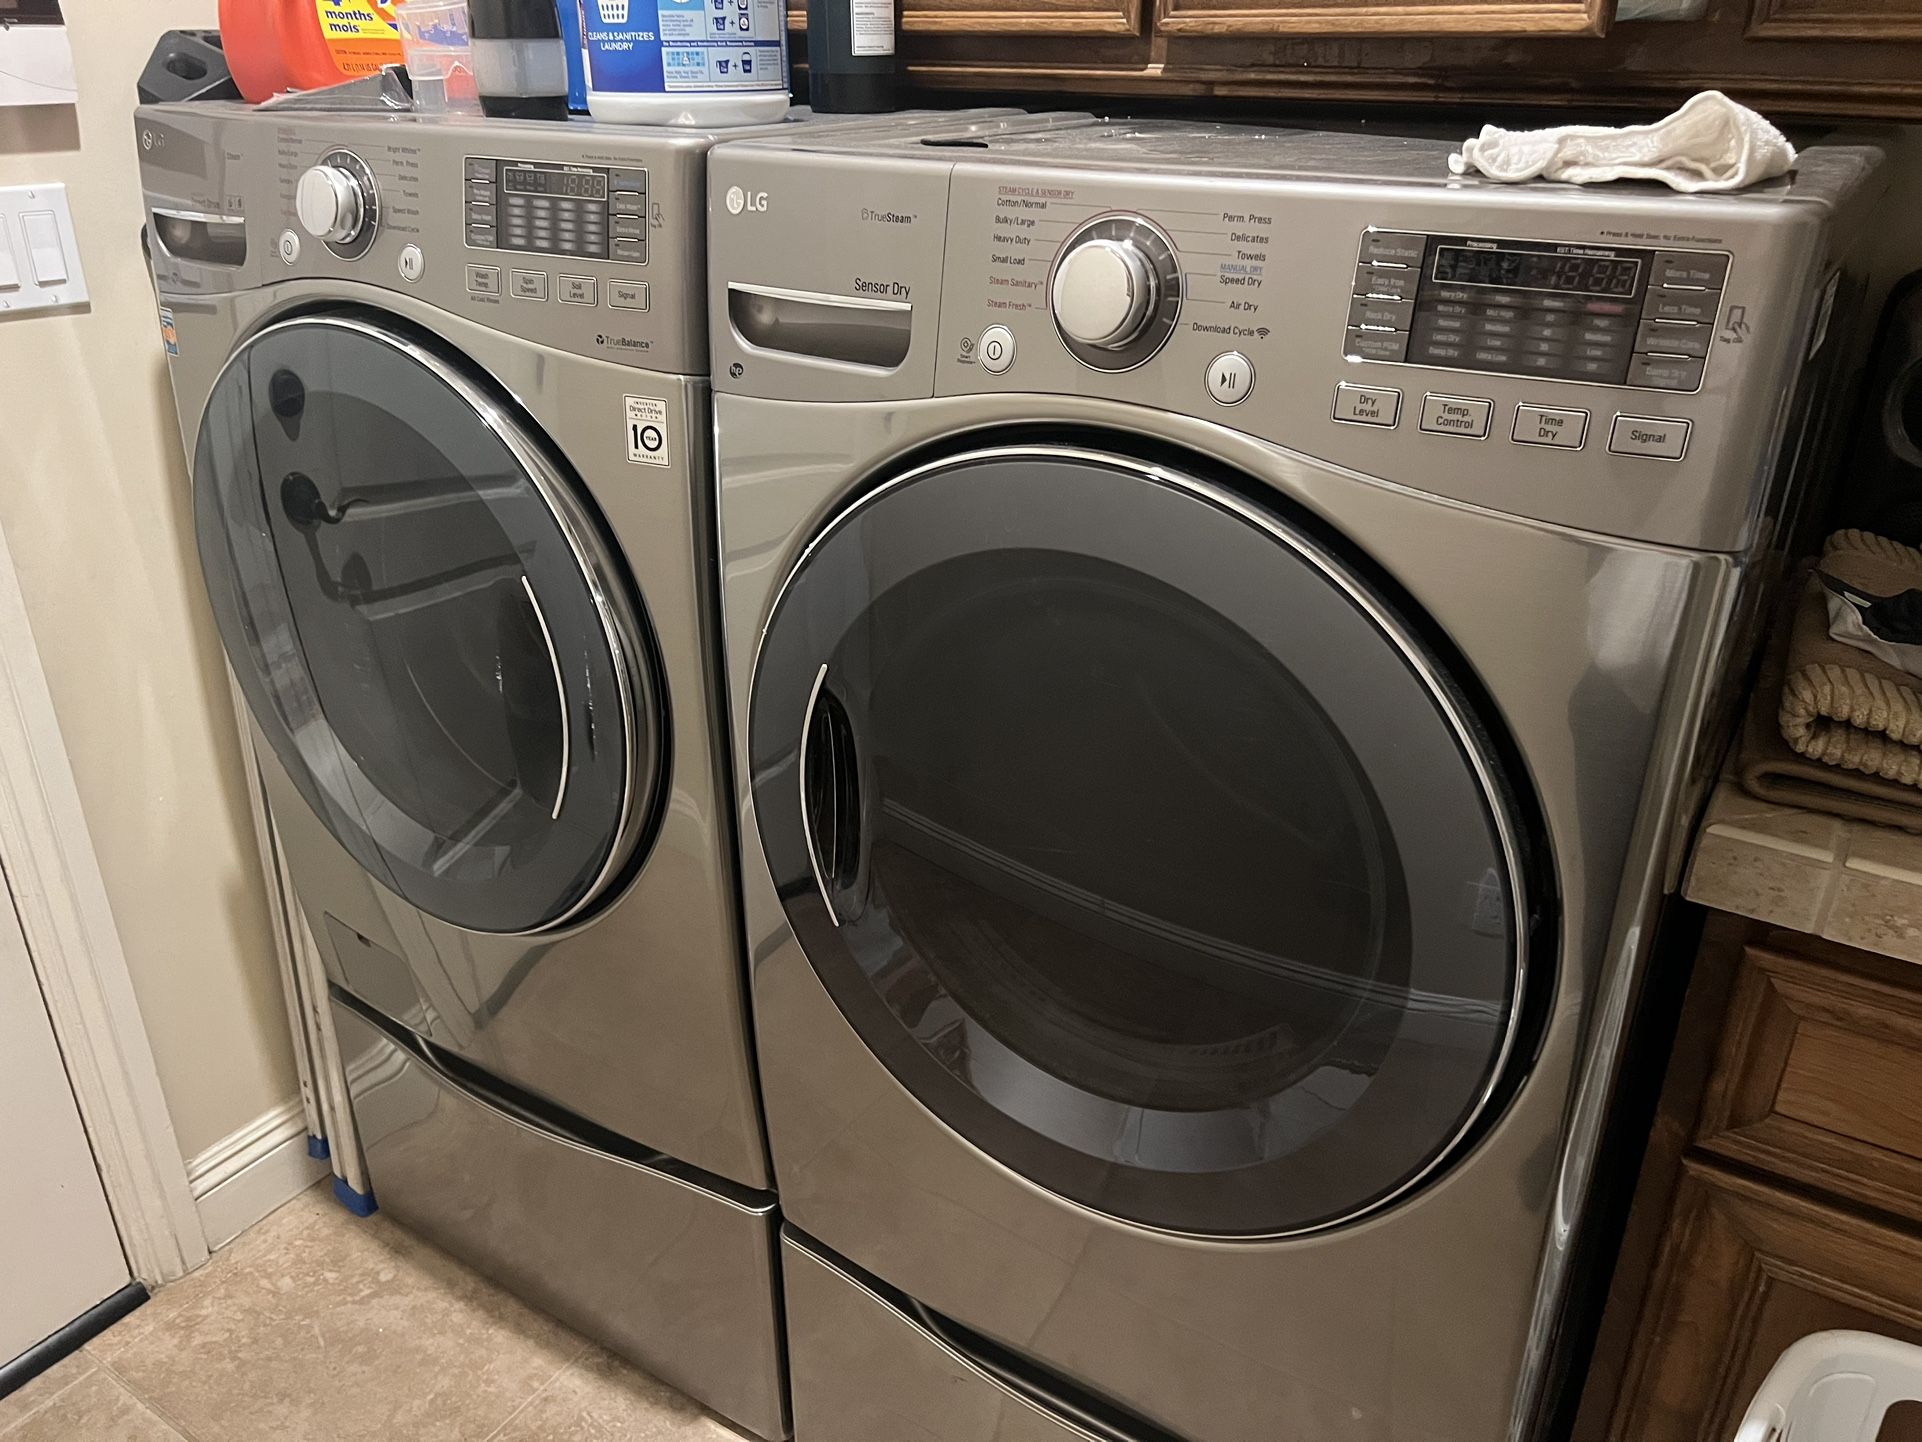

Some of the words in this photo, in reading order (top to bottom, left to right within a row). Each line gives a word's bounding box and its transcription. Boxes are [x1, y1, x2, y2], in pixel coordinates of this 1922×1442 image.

[325, 10, 374, 21] months
[329, 22, 360, 33] mois
[588, 32, 608, 40] CLEANS
[608, 32, 614, 40] &
[614, 32, 654, 40] SANITIZES
[601, 42, 633, 50] LAUNDRY
[998, 186, 1016, 194] STEAM
[1040, 189, 1062, 197] SENSOR
[747, 191, 768, 211] LG
[997, 197, 1047, 209] Cotton/Normal
[995, 215, 1035, 228] Bulky/Large
[1222, 213, 1246, 223] Perm.
[1248, 214, 1272, 225] Press
[993, 233, 1014, 245] Heavy
[1015, 235, 1031, 246] Duty
[1230, 232, 1269, 244] Delicates
[991, 254, 1008, 264] Small
[1009, 256, 1025, 265] Load
[1237, 250, 1266, 262] Towels
[1220, 263, 1248, 273] MANUAL
[1249, 265, 1263, 274] DRY
[523, 277, 534, 285] Spin
[989, 276, 1009, 286] Steam
[1219, 275, 1246, 287] Speed
[1247, 276, 1262, 288] Dry
[521, 285, 537, 294] Speed
[855, 278, 889, 294] Sensor
[892, 281, 911, 299] Dry
[570, 291, 584, 299] Level
[618, 290, 635, 300] Signal
[987, 299, 1007, 309] Steam
[1229, 300, 1241, 310] Air
[1243, 301, 1258, 313] Dry
[1192, 322, 1231, 335] Download
[1232, 325, 1255, 337] Cycle
[1359, 395, 1377, 408] Dry
[629, 405, 646, 413] Direct
[647, 407, 662, 415] Drive
[1353, 405, 1379, 418] Level
[1441, 404, 1471, 417] Temp.
[1436, 416, 1474, 429] Control
[1538, 415, 1564, 427] Time
[632, 424, 662, 452] 10
[1538, 427, 1558, 441] Dry
[1630, 430, 1666, 445] Signal
[633, 453, 664, 461] WARRANTY
